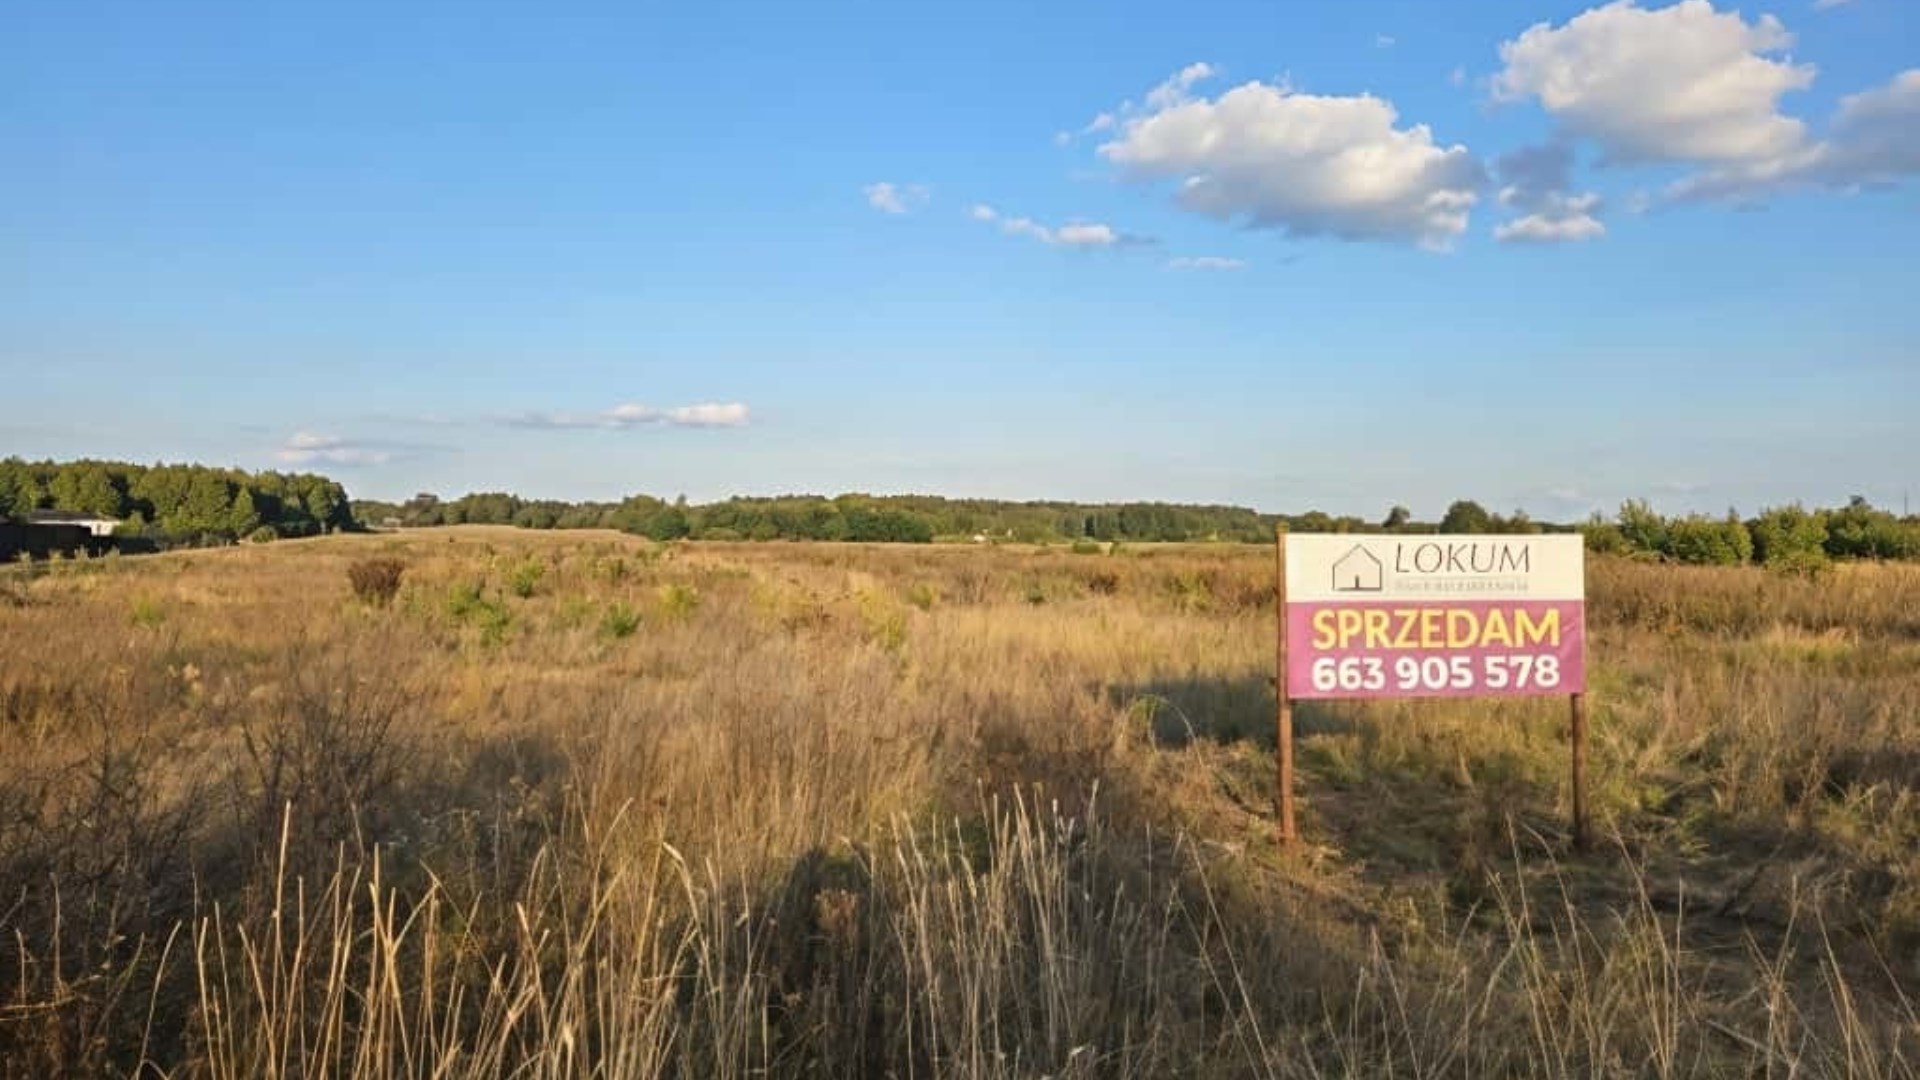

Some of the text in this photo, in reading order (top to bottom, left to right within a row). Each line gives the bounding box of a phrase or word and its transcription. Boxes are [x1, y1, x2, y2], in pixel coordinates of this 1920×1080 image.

[1396, 542, 1530, 573] LOKUM
[1312, 608, 1560, 650] SPRZEDAM
[1312, 654, 1560, 691] 663 905 578
